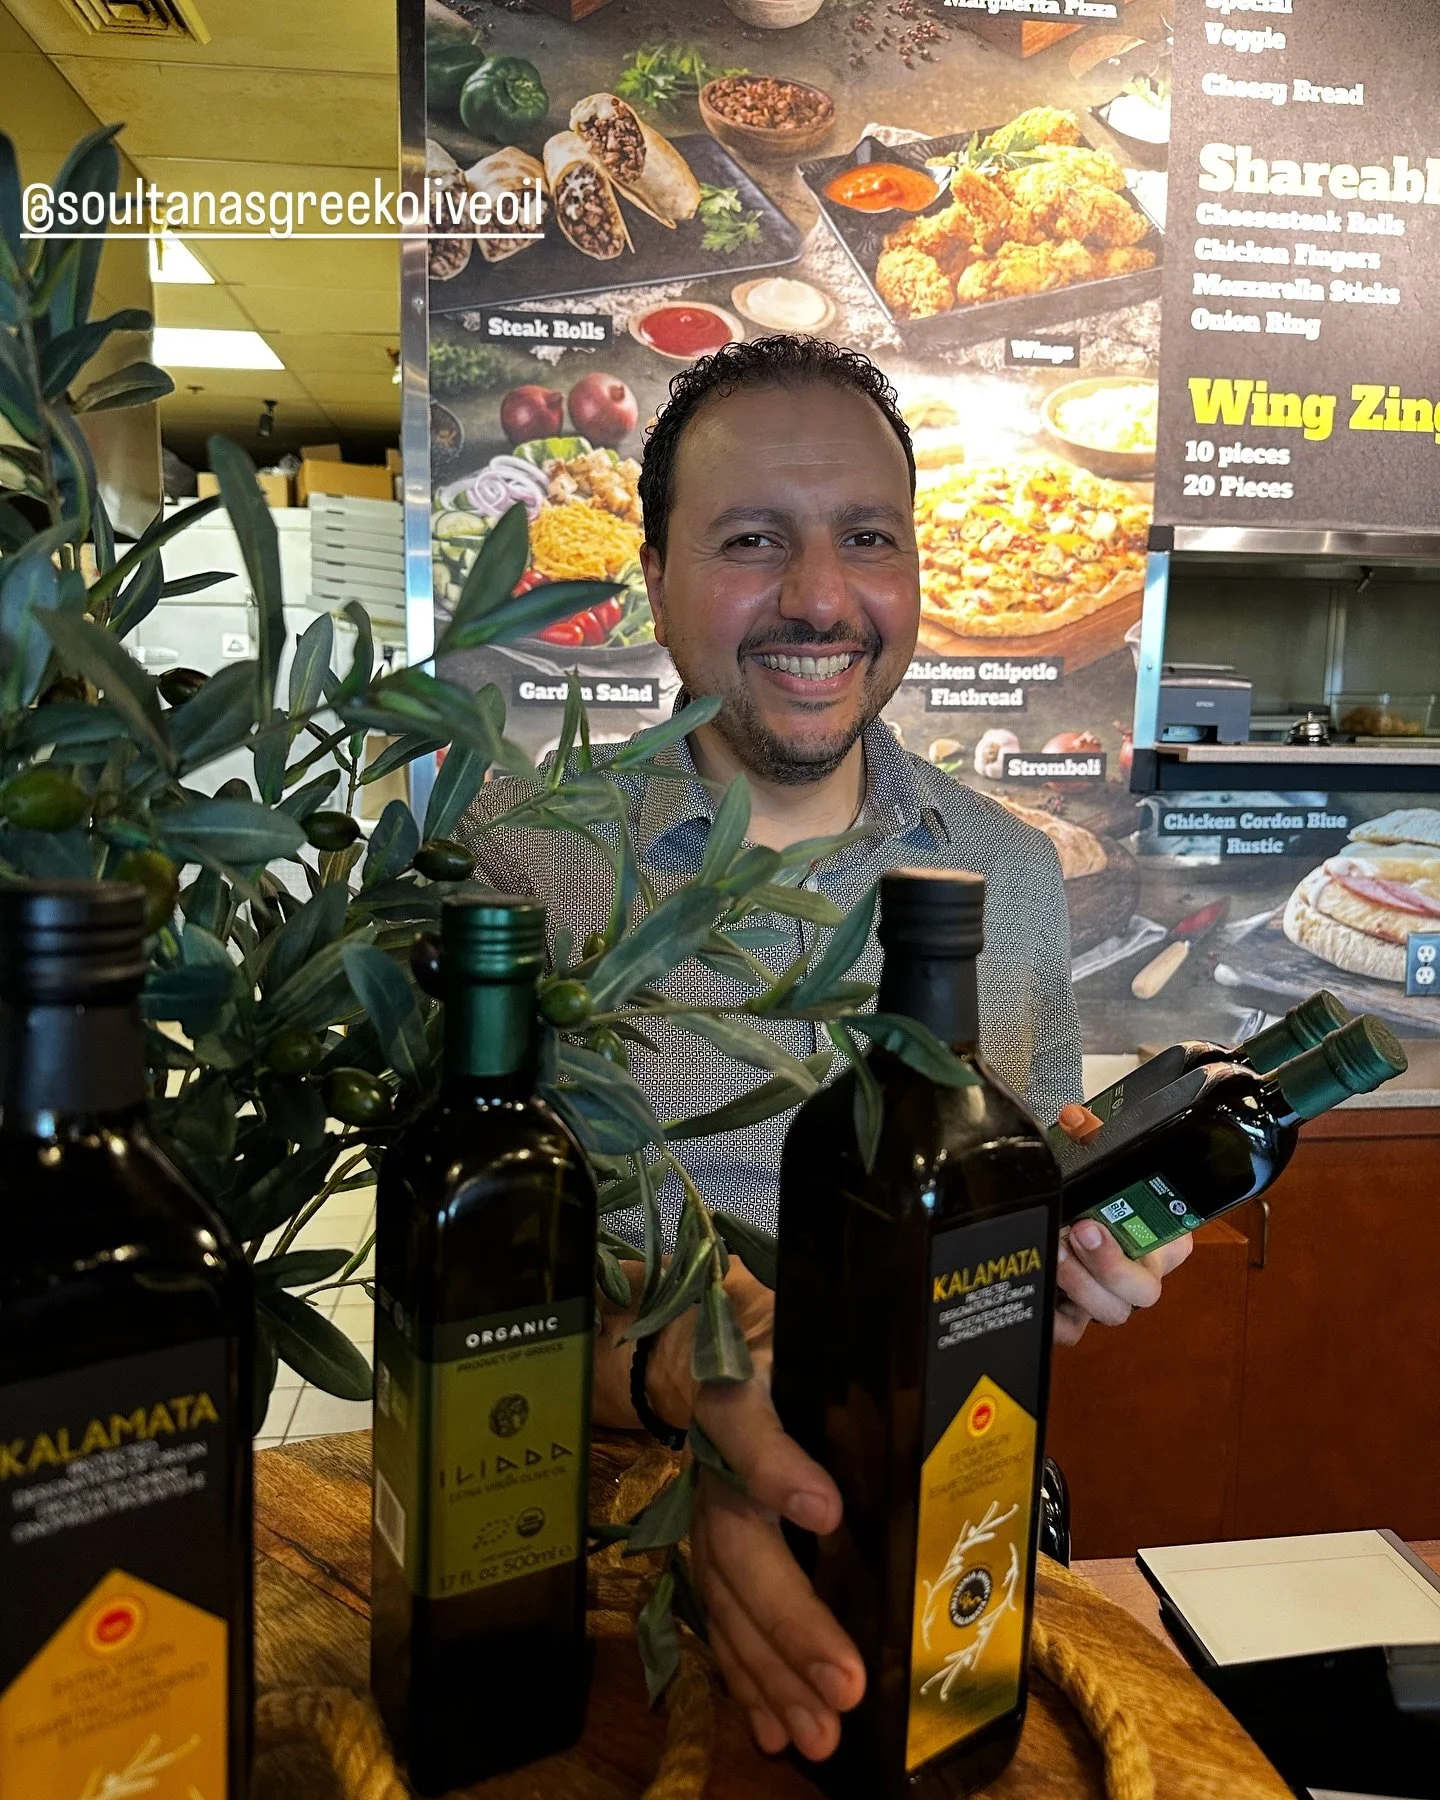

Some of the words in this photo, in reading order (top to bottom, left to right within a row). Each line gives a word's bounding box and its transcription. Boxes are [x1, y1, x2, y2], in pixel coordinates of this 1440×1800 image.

[1204, 21, 1287, 53] Veggie
[1202, 72, 1288, 106] Cheesy
[1292, 79, 1364, 105] Bread
[1195, 202, 1342, 232] Cheesesteak
[1346, 210, 1406, 236] Rolls
[1194, 237, 1290, 265] Chicken
[1294, 243, 1381, 272] Fingers
[1192, 272, 1325, 301] Mozzarella
[1329, 279, 1401, 305] Sticks
[488, 316, 549, 338] Steak
[552, 319, 606, 341] Rolls
[1190, 307, 1261, 333] Onion
[1265, 311, 1322, 340] Ring
[1010, 339, 1075, 365] Wings
[1187, 377, 1338, 442] Wing
[1348, 383, 1440, 445] Zin
[1184, 440, 1215, 463] 10
[1217, 441, 1291, 468] pieces
[1182, 473, 1216, 496] 20
[1219, 475, 1294, 499] Pieces
[978, 662, 1059, 684] Chipotle
[519, 681, 593, 701] Gardn
[596, 682, 653, 702] Salad
[930, 687, 1024, 706] Flatbread
[1007, 758, 1101, 777] Stromboli
[1163, 812, 1236, 830] Chicken
[1239, 811, 1304, 830] Cordon
[1307, 812, 1348, 830] Blue
[1226, 836, 1285, 855] Rustic
[932, 1247, 1042, 1304] KALAMATA
[465, 1316, 560, 1349] ORGANIC
[0, 1391, 220, 1484] KALAMATA
